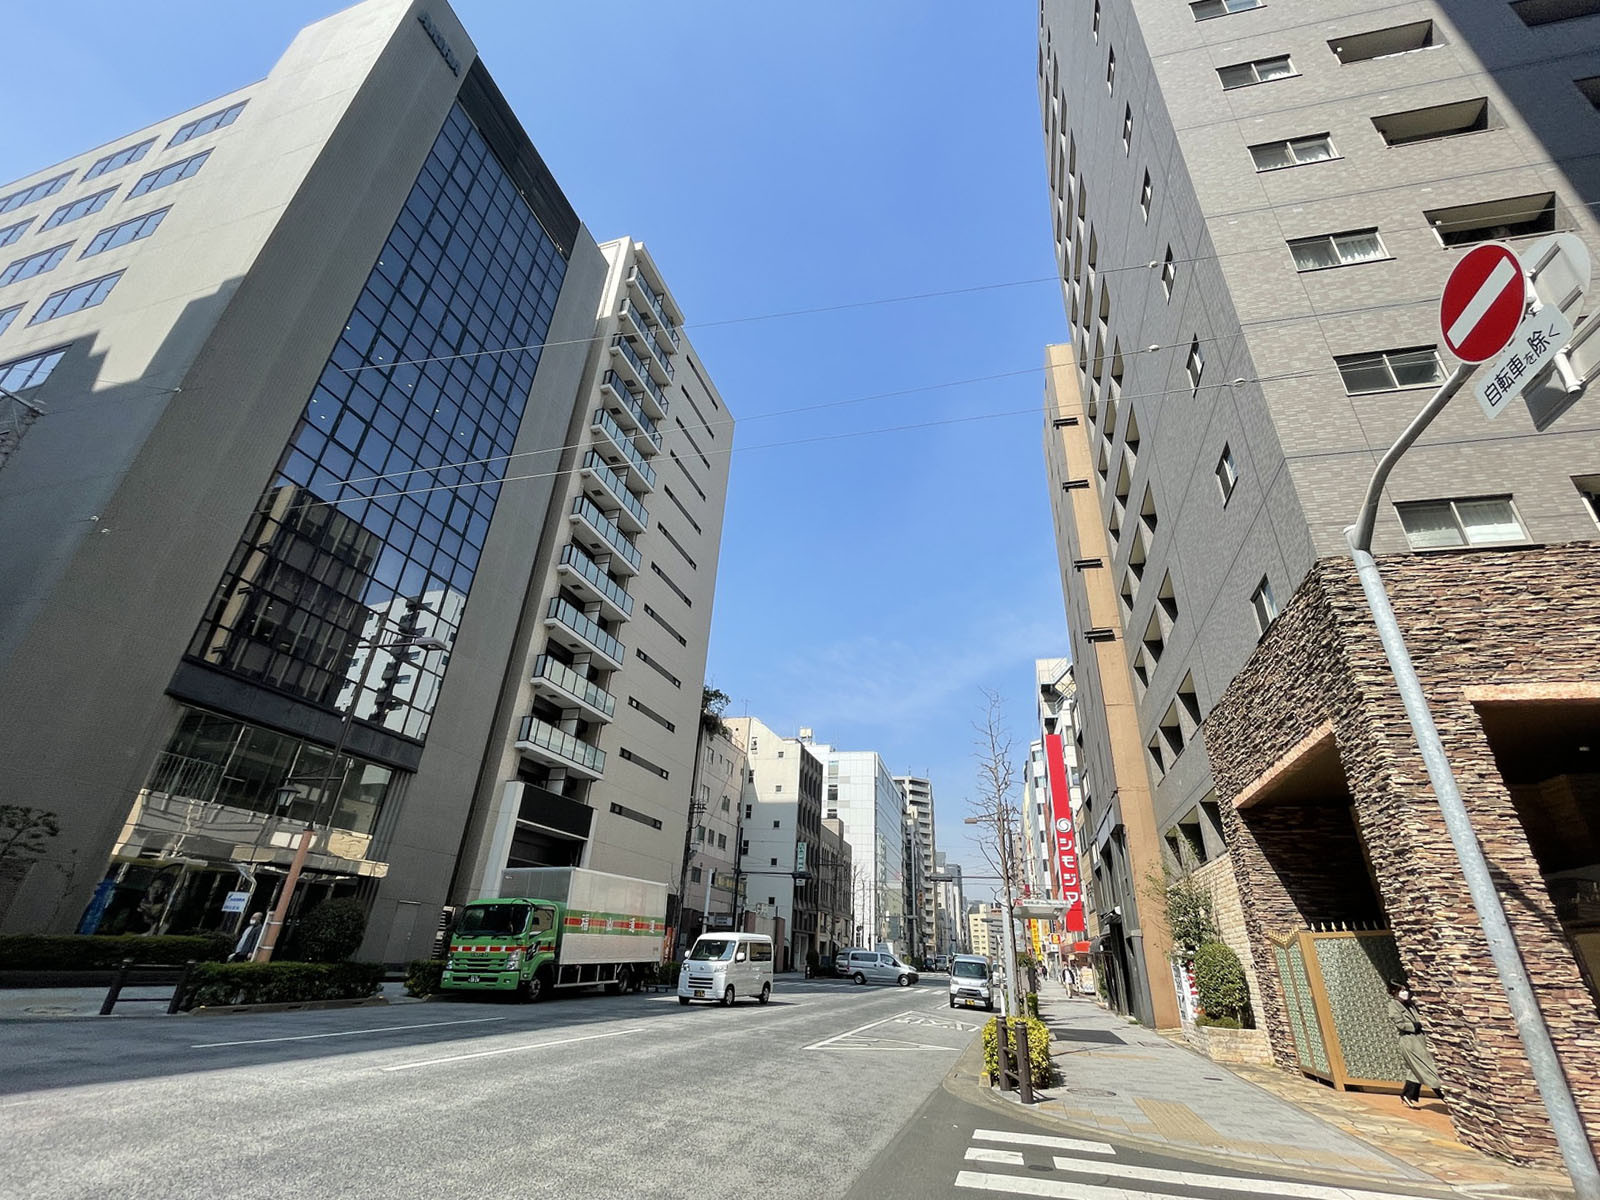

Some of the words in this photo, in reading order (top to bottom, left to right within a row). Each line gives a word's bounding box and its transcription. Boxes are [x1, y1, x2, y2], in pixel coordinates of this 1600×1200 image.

[1484, 323, 1561, 407] 自転車を除く
[1059, 838, 1079, 905] シモジマ
